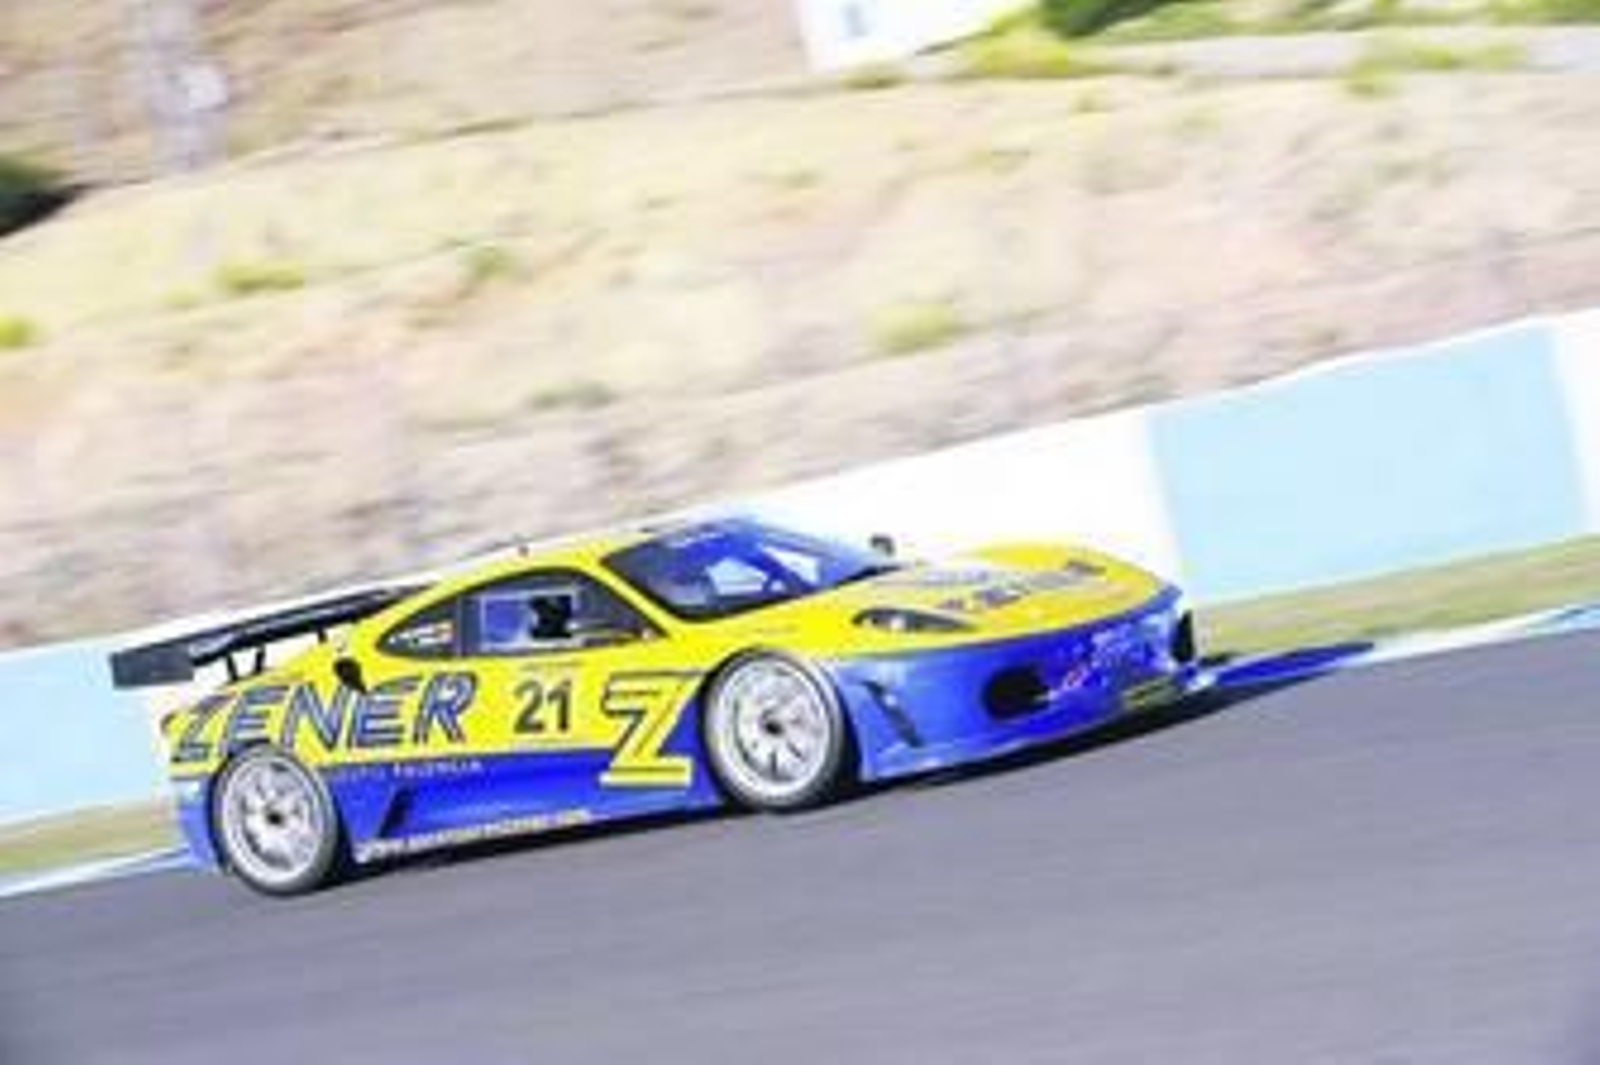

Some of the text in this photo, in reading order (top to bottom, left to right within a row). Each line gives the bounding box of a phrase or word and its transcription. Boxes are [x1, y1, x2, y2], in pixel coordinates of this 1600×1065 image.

[170, 671, 477, 764] ZENER
[513, 679, 573, 733] 21
[600, 668, 704, 786] Z
